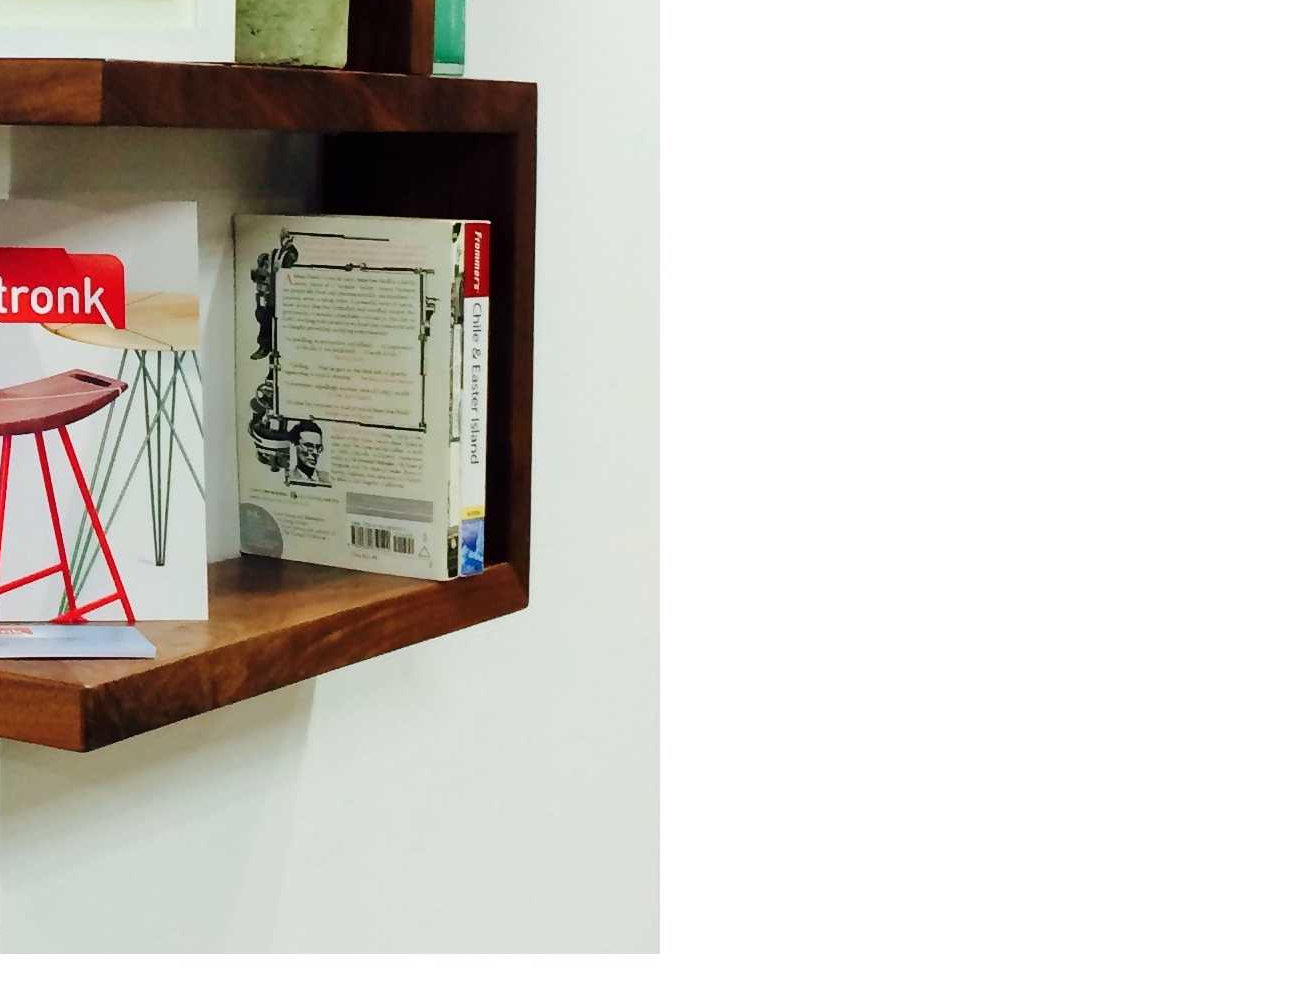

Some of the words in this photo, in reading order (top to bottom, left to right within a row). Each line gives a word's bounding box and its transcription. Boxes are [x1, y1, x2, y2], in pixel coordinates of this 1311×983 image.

[472, 303, 482, 343] Chile
[472, 348, 481, 360] &
[471, 365, 480, 412] Easter
[470, 419, 479, 464] Island
